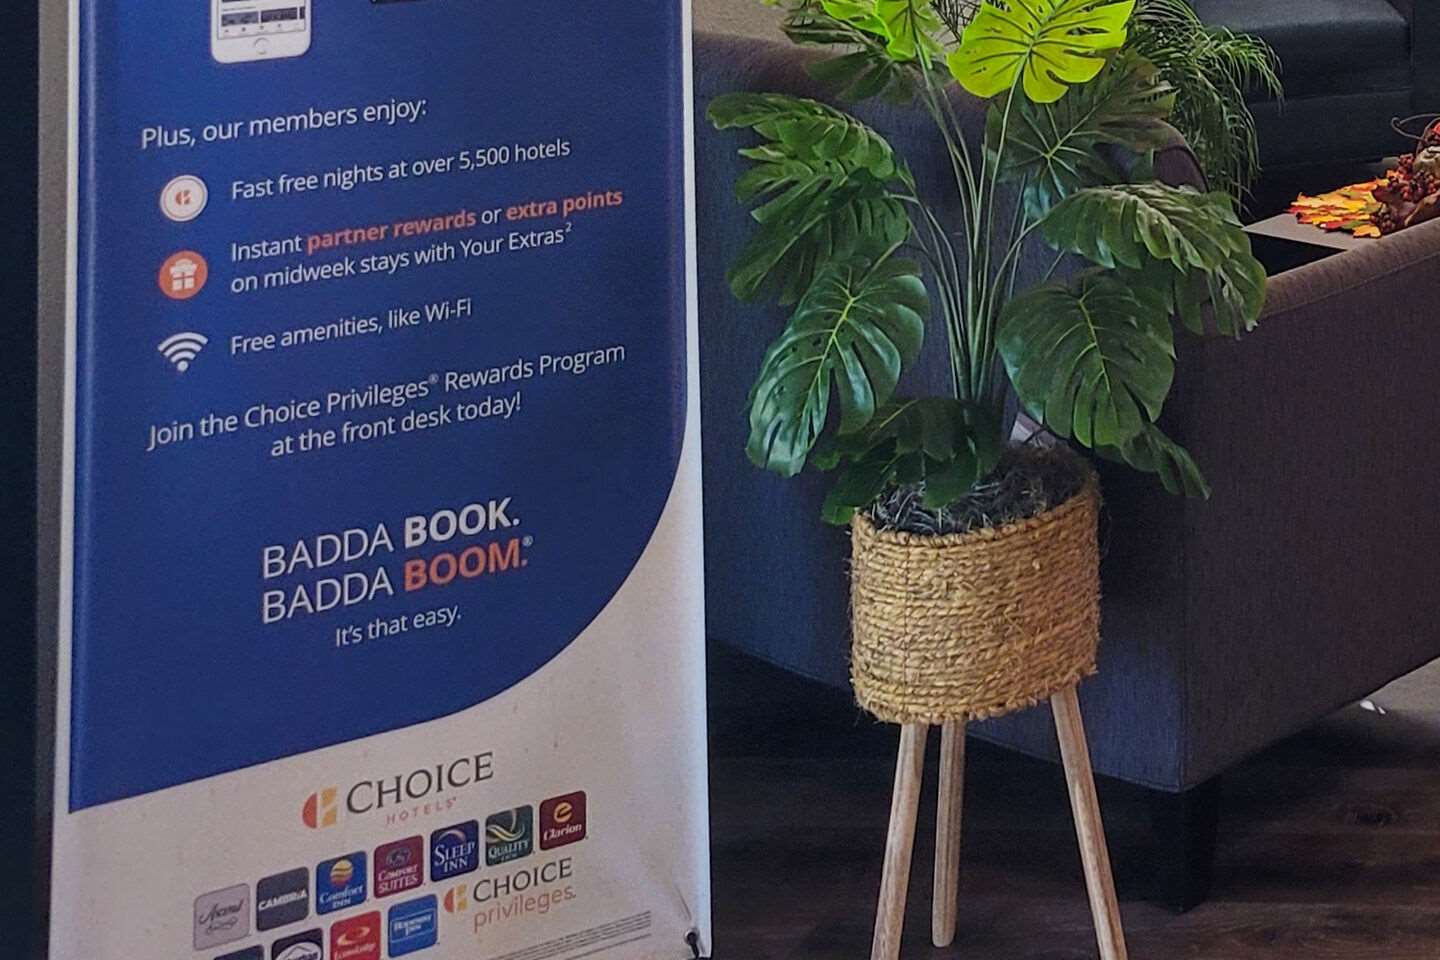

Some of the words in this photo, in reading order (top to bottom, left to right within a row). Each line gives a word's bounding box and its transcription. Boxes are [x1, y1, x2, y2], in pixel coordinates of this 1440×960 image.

[141, 126, 196, 149] Plus,
[203, 121, 243, 141] our
[249, 107, 357, 136] members
[363, 99, 427, 124] enjoy:
[232, 178, 273, 200] Fast
[279, 174, 318, 193] free
[324, 163, 384, 189] nights
[388, 161, 408, 179] at
[412, 156, 454, 175] over
[459, 146, 510, 171] 5,500
[515, 139, 571, 162] hotels
[232, 235, 302, 261] Instant
[306, 224, 388, 255] partner
[393, 209, 476, 237] rewards
[481, 209, 502, 224] or
[506, 199, 558, 221] extra
[562, 190, 623, 217] points
[231, 275, 258, 293] on
[263, 257, 355, 287] midweek
[360, 252, 410, 275] stays
[414, 243, 455, 265] with
[460, 237, 504, 256] Your
[231, 335, 275, 354] Free
[281, 316, 384, 346] amenities,
[388, 308, 420, 329] like
[425, 298, 472, 322] Wi-Fi
[147, 421, 193, 451] Join
[200, 414, 238, 436] the
[244, 400, 320, 428] Choice
[445, 359, 533, 392] Rewards
[539, 345, 625, 375] Program
[271, 436, 294, 456] at
[299, 429, 336, 451] the
[342, 416, 396, 444] front
[401, 405, 452, 432] desk
[457, 391, 521, 422] today!
[263, 523, 394, 579] BADDA
[404, 498, 520, 548] BOOK.
[263, 566, 394, 624] BADDA
[368, 615, 408, 639] that
[414, 605, 462, 632] easy.
[346, 751, 494, 815] CHOICE
[434, 842, 475, 866] SLEEP
[488, 840, 528, 858] QUALITY
[544, 824, 582, 841] Clarion
[378, 874, 418, 893] SUITES
[444, 859, 469, 873] INN
[473, 857, 573, 902] CHOICE
[320, 885, 363, 905] Comfort
